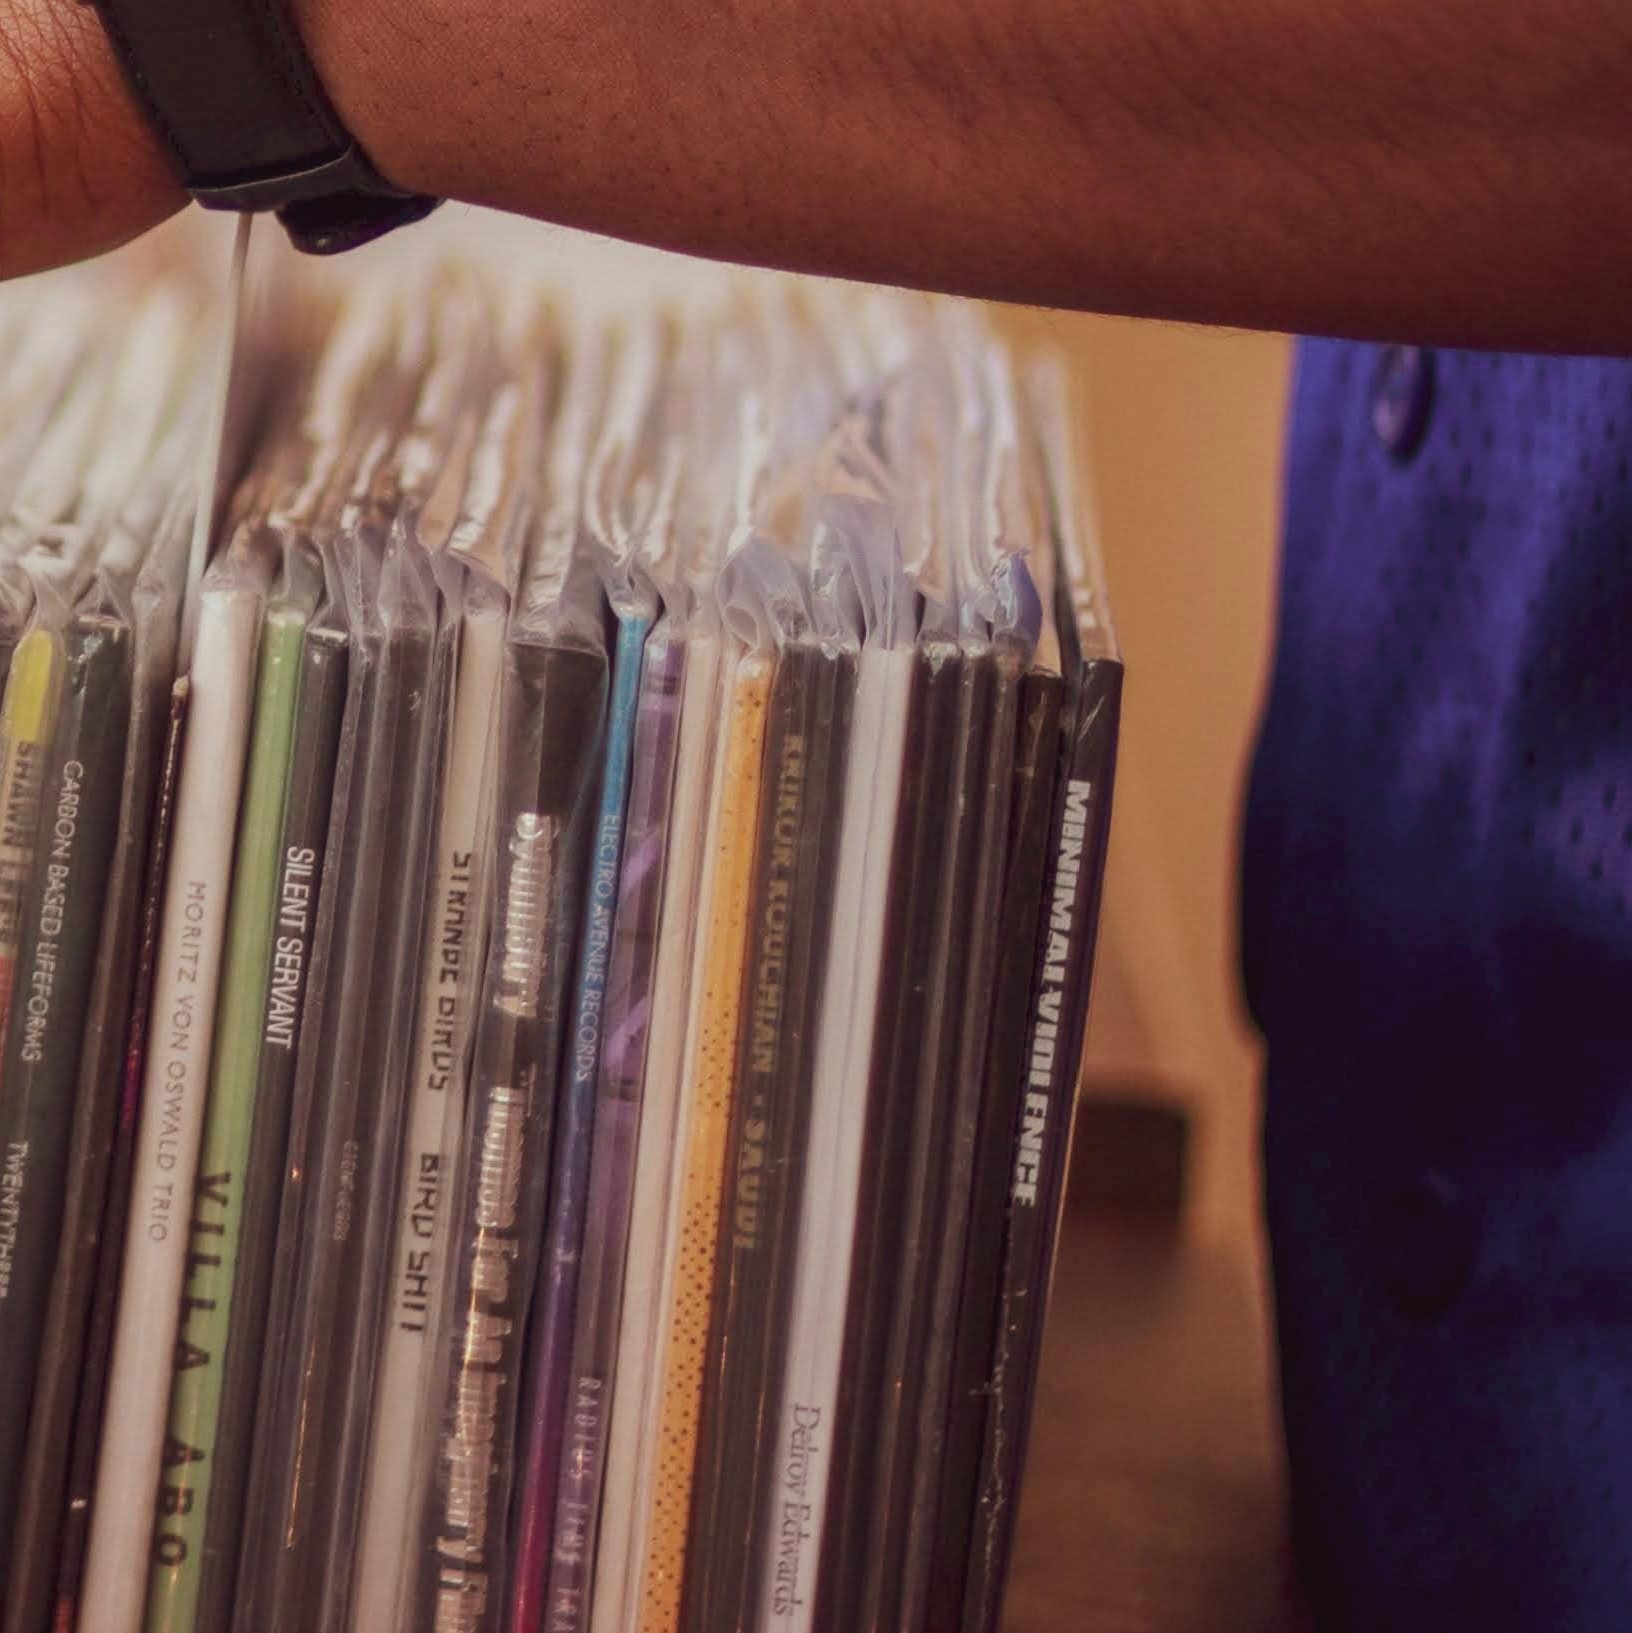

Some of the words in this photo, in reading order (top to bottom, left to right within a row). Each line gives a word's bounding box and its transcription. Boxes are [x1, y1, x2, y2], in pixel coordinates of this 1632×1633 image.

[0, 741, 36, 849] SHAWN
[52, 759, 83, 858] CARBON
[771, 734, 804, 867] KRIKOR
[39, 862, 68, 937] BASED
[279, 846, 312, 931] SILENT
[594, 813, 617, 897] ELECTRO
[1045, 780, 1087, 982] MINIMAL
[178, 881, 204, 982] MORITZ
[440, 851, 473, 984] STRANGE
[585, 905, 607, 983] AVENUE
[21, 940, 57, 1063] LIFEFORMS
[170, 993, 191, 1050] VON
[266, 935, 301, 1047] SERVANT
[750, 879, 791, 1072] KOUCHIAN
[575, 989, 598, 1083] RECORDS
[158, 1060, 184, 1171] OSWALD
[1015, 989, 1058, 1206] VIOLENCE
[149, 1181, 171, 1242] TRIO
[412, 1152, 443, 1238] BIRD
[178, 1168, 227, 1374] VILLA
[400, 1250, 430, 1333] SHIT
[782, 1403, 819, 1494] Delroy
[155, 1437, 201, 1569] ABO
[775, 1502, 809, 1617] Edwards
